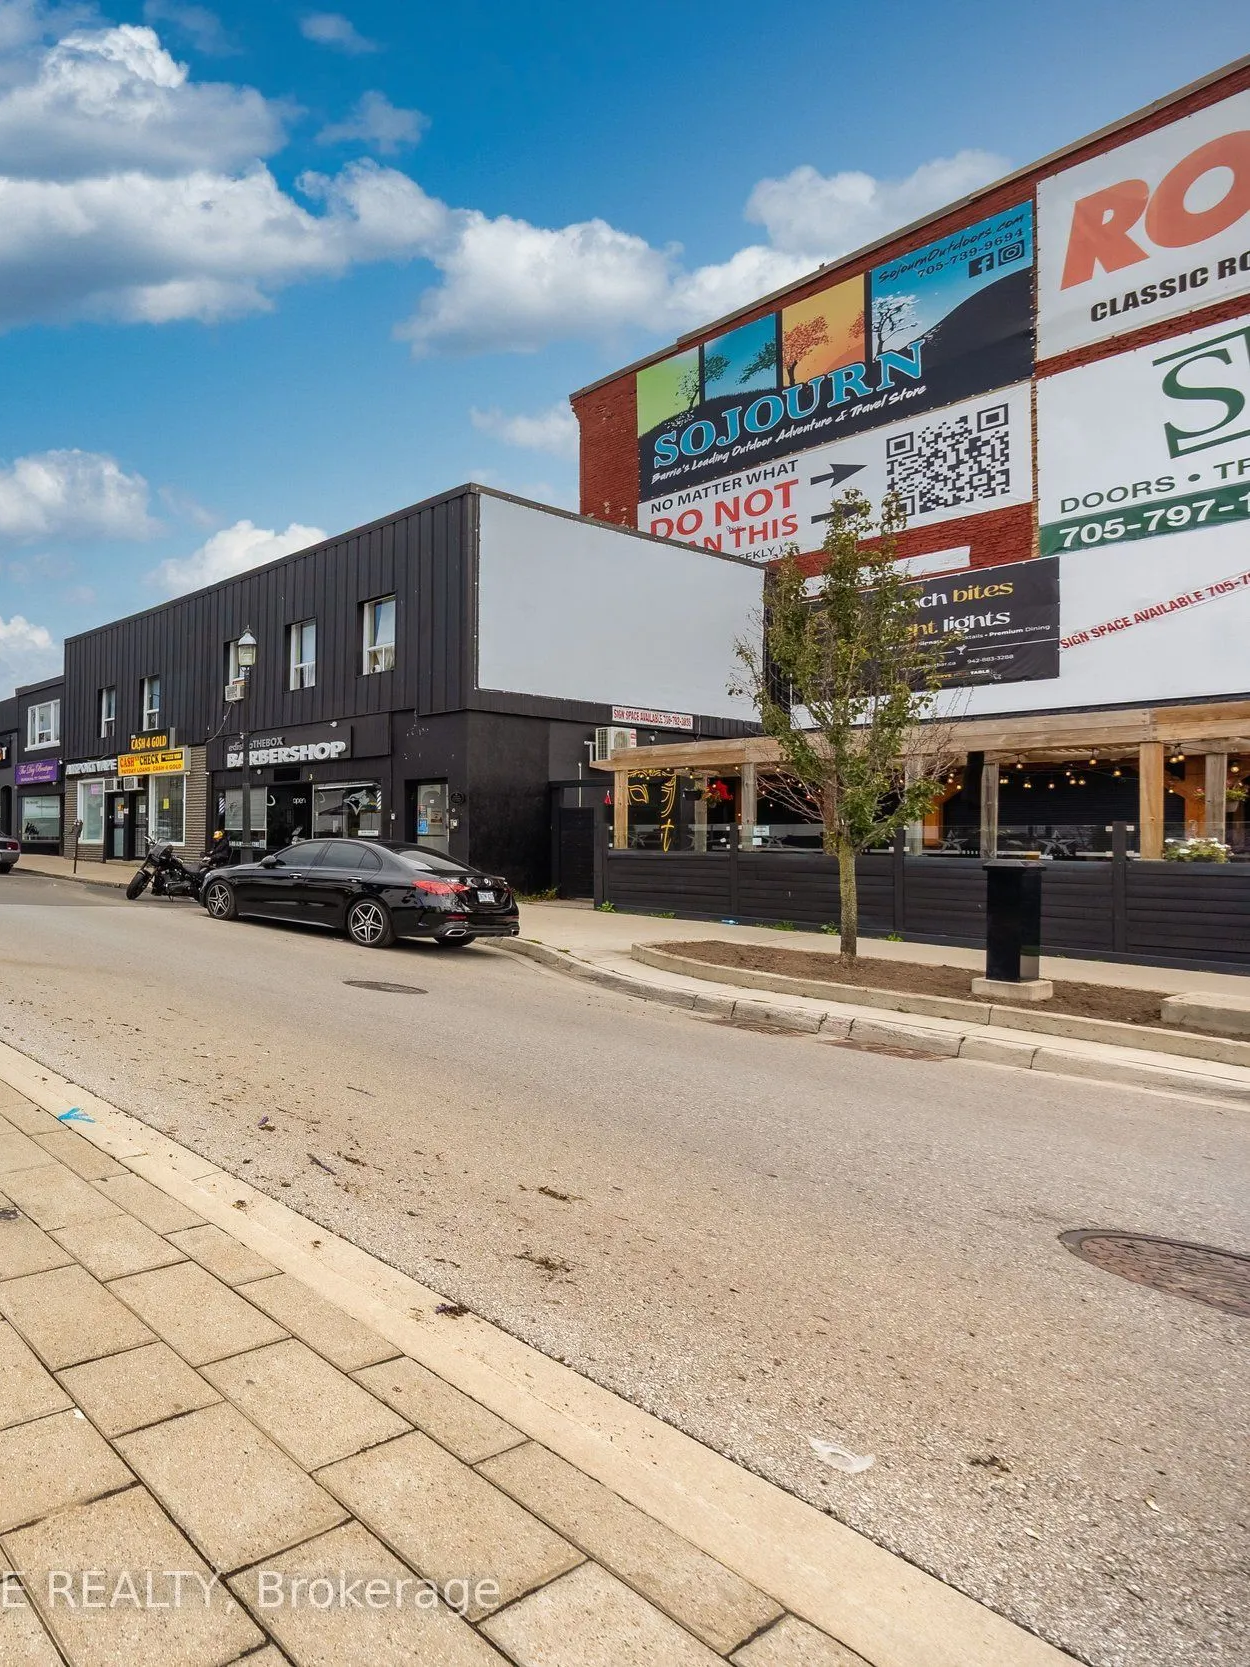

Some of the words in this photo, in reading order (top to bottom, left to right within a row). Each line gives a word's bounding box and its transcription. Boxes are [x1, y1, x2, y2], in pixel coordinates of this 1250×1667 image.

[918, 228, 1024, 278] 705-739-9694
[1091, 267, 1209, 322] CLASSIC
[654, 339, 926, 468] SOJOURN
[651, 463, 690, 484] Barrie's
[691, 451, 729, 471] Leading
[731, 437, 773, 457] Outdoor
[775, 416, 833, 442] Adventure
[849, 400, 887, 418] Travel
[887, 385, 928, 406] Store
[651, 499, 673, 514] NO
[677, 477, 742, 506] MATTER
[746, 460, 799, 485] WHAT
[1060, 475, 1176, 514] DOORS
[651, 509, 703, 540] DO
[715, 479, 799, 526] NOT
[729, 514, 799, 548] THIS
[952, 582, 1014, 603] bites
[943, 611, 1011, 634] lights
[988, 628, 1024, 637] Premium
[1025, 624, 1051, 633] Dining
[1060, 631, 1089, 649] SIGN
[1090, 617, 1133, 638] SPACE
[1133, 591, 1205, 624] AVAILABLE
[613, 709, 625, 719] SIGN
[625, 711, 640, 721] SPACE
[640, 713, 663, 724] AVAILABLE
[151, 735, 167, 748] GOLD
[226, 741, 346, 768] BARBERSHOP
[120, 756, 135, 768] CASH
[139, 753, 160, 765] CHECK
